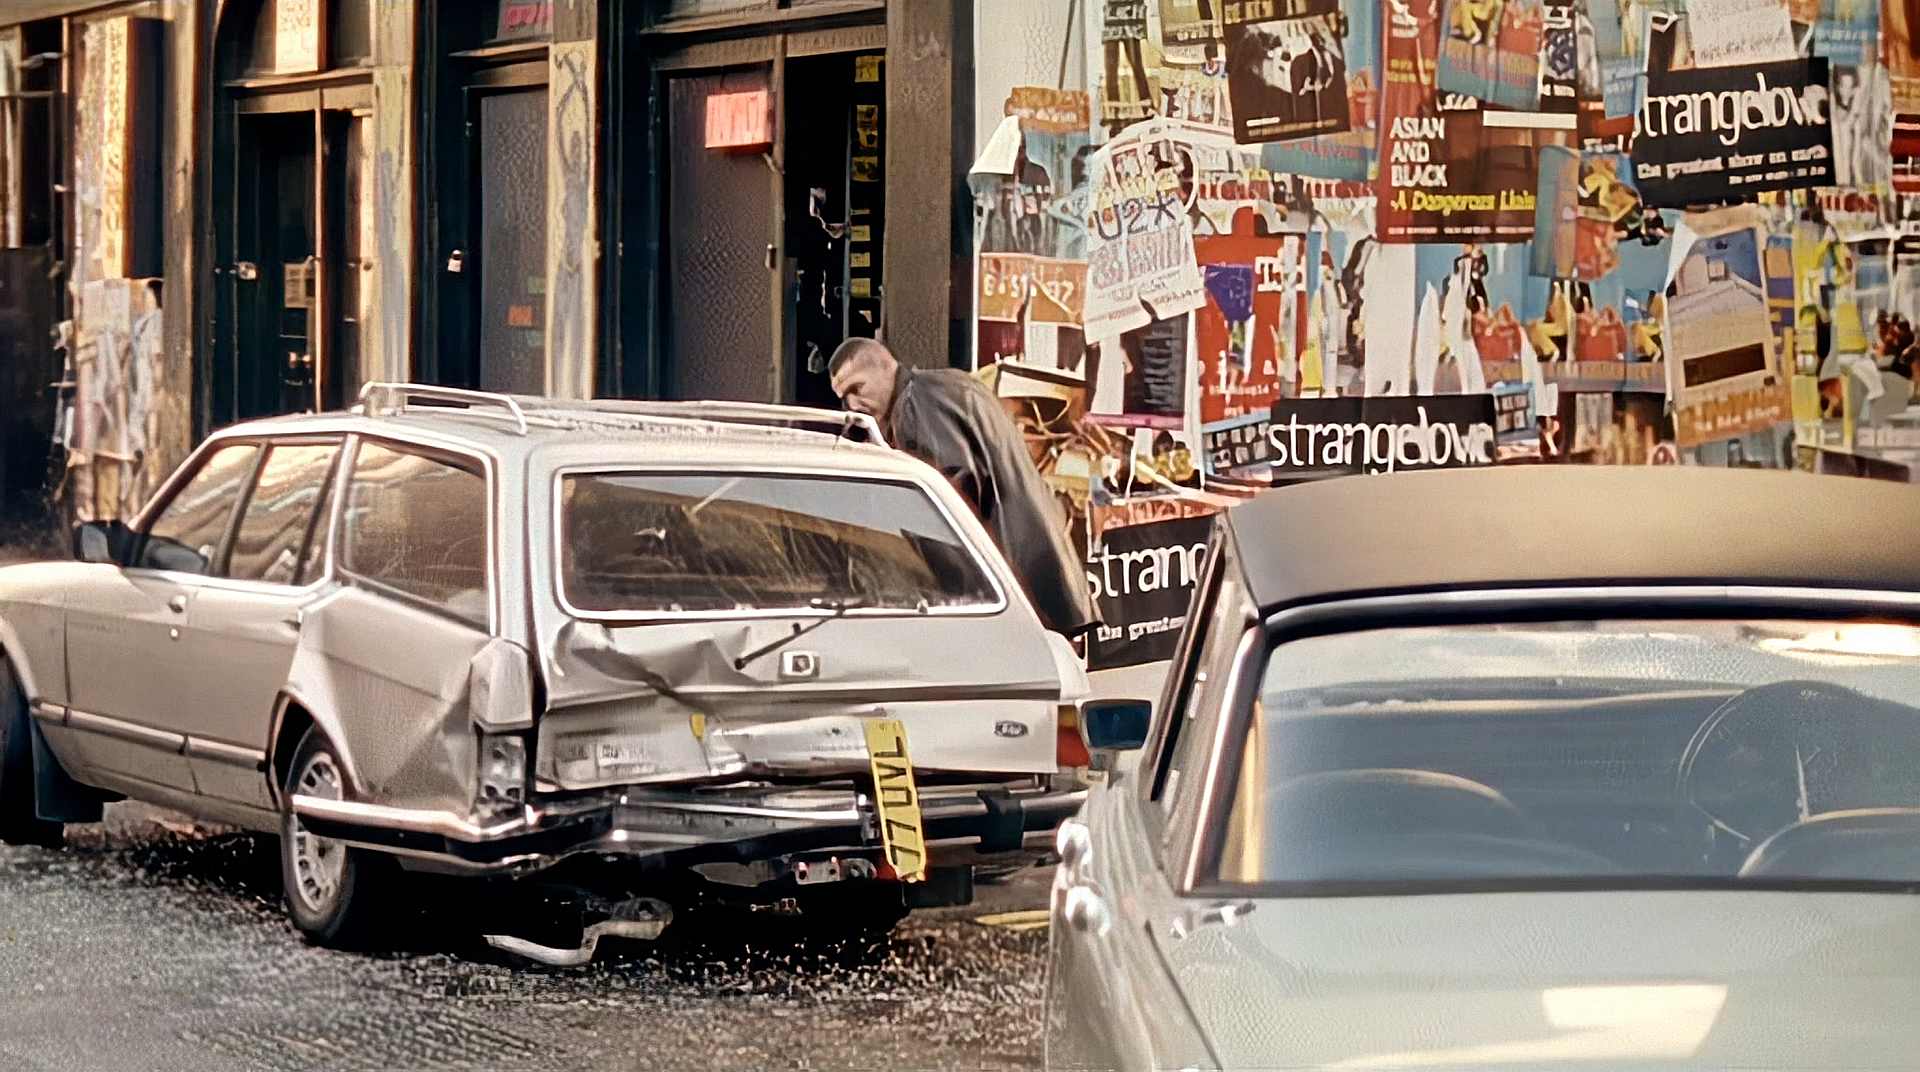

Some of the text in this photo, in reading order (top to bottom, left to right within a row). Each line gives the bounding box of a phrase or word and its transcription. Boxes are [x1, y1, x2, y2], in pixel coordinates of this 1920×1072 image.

[1390, 117, 1445, 139] ASIAN
[1391, 141, 1430, 162] AND
[1391, 164, 1447, 187] BLACK
